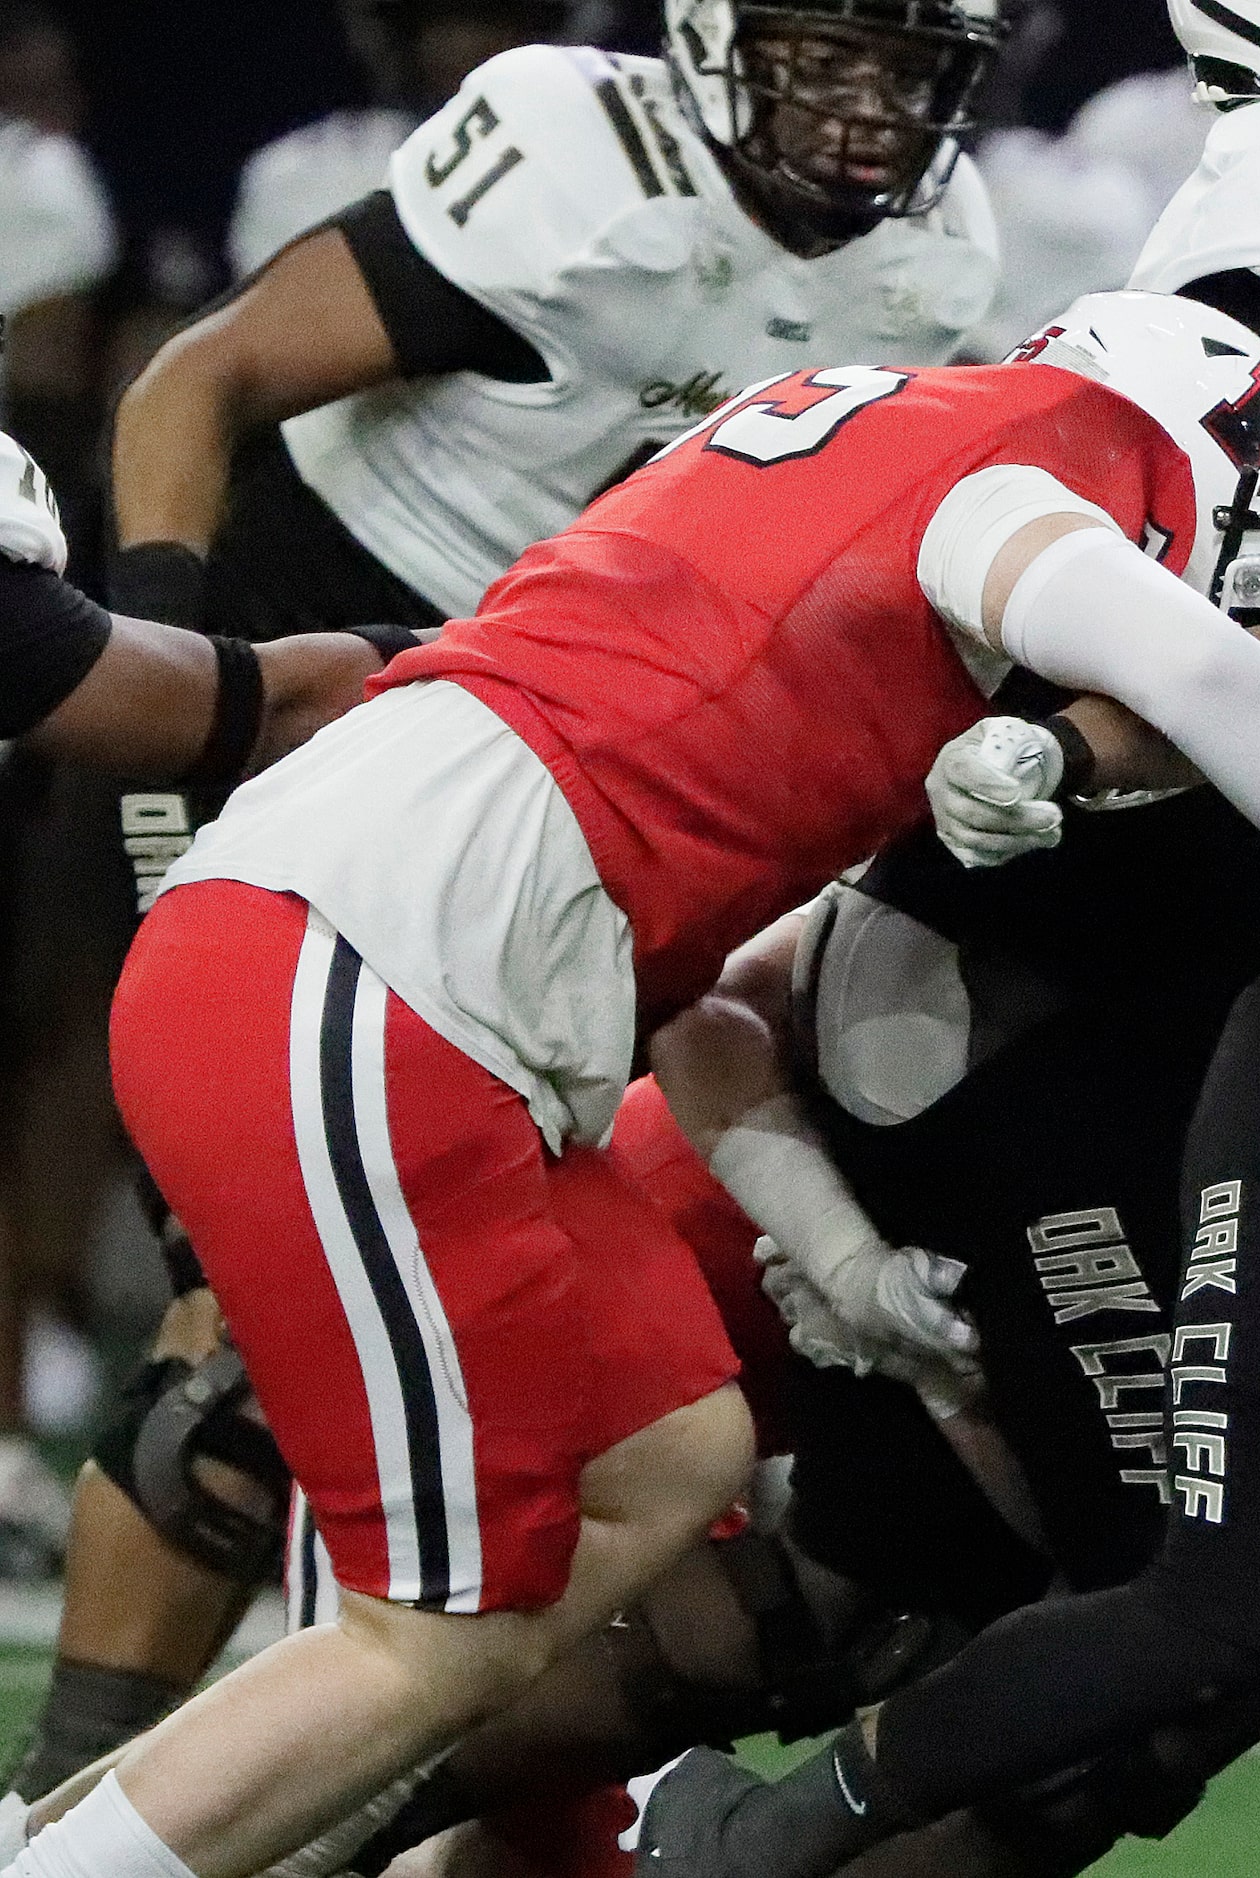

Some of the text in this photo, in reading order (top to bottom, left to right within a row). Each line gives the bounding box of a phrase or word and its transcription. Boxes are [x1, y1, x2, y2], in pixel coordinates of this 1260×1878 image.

[424, 95, 525, 228] 51
[1026, 1206, 1162, 1326] OAK
[1170, 1179, 1243, 1525] OAK CLIFF
